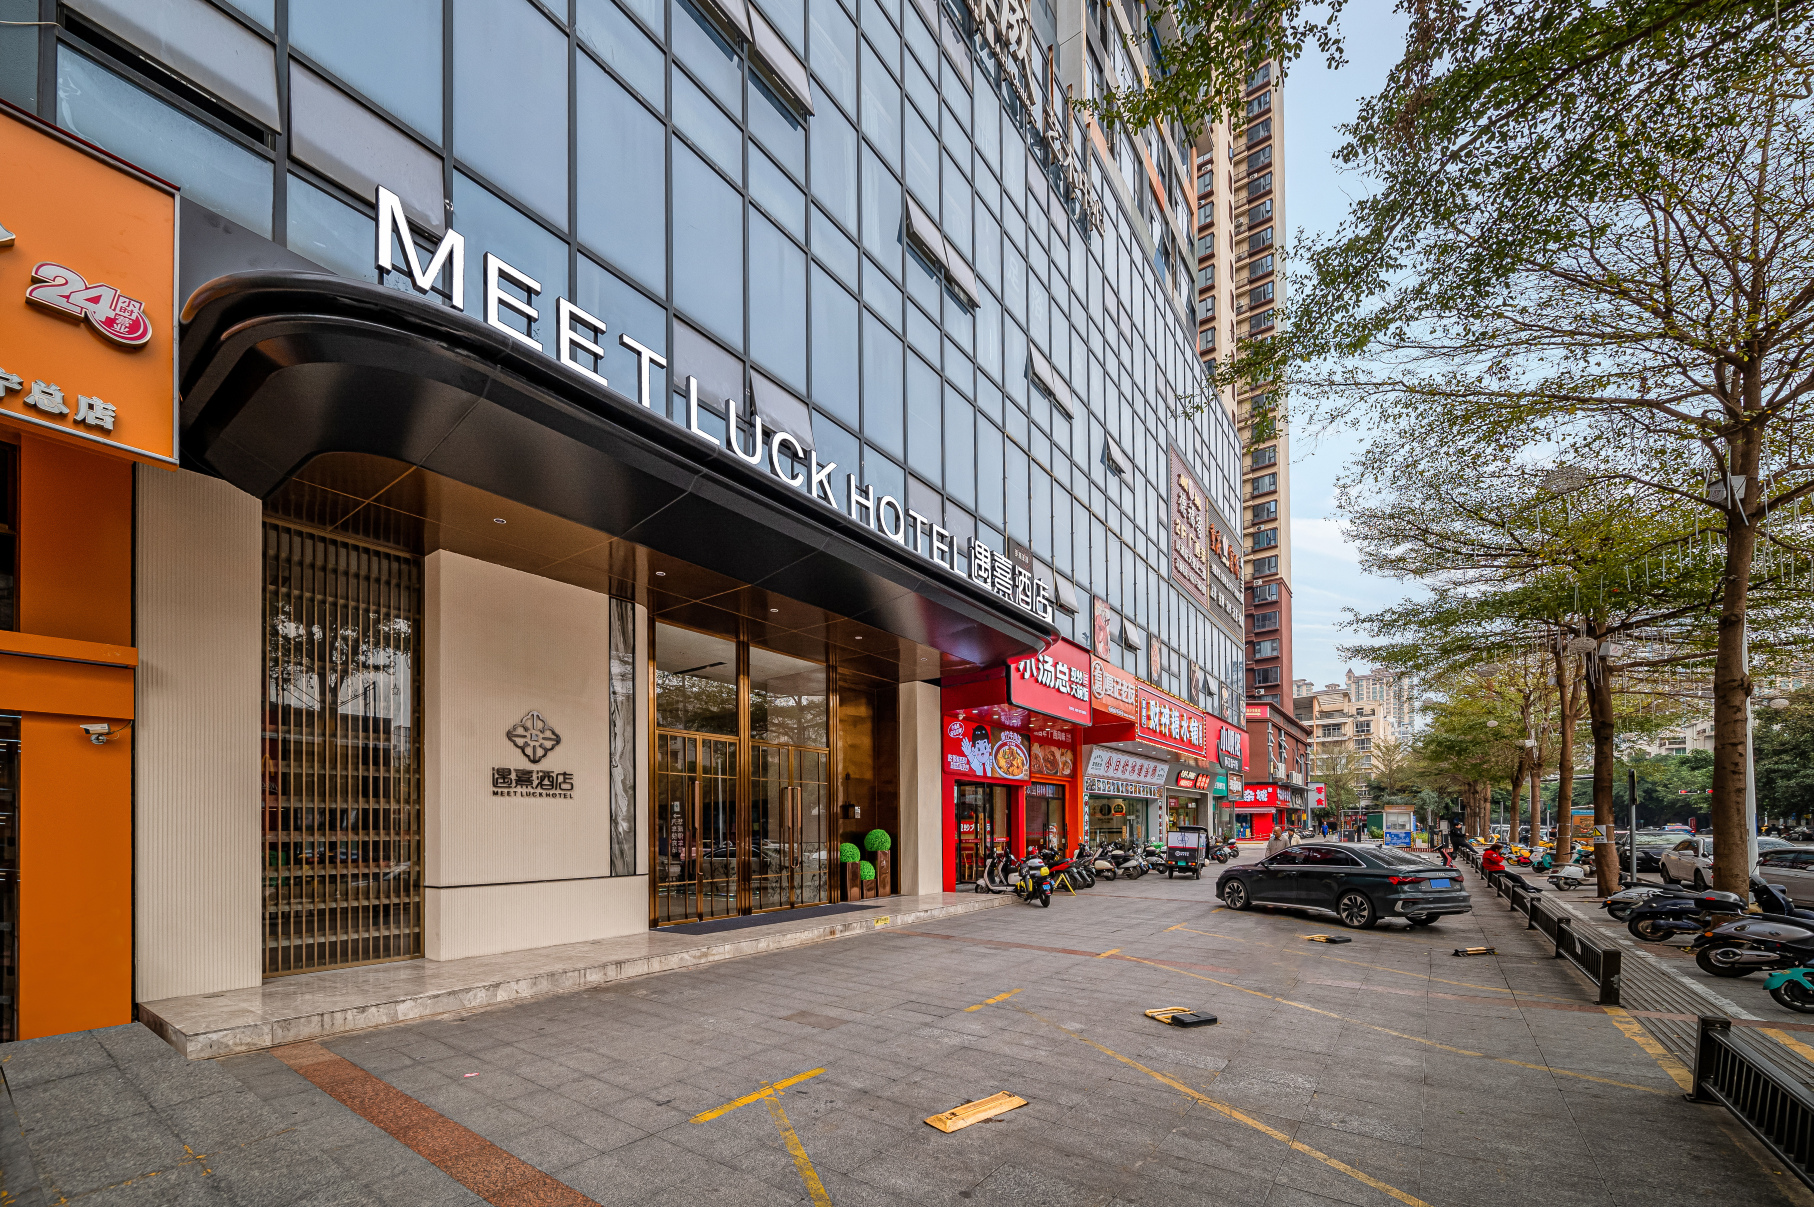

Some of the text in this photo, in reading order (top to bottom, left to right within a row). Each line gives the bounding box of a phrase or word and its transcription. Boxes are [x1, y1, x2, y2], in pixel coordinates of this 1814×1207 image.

[375, 184, 967, 578] MEET LUCK HOTEL
[545, 791, 573, 799] HOTEL
